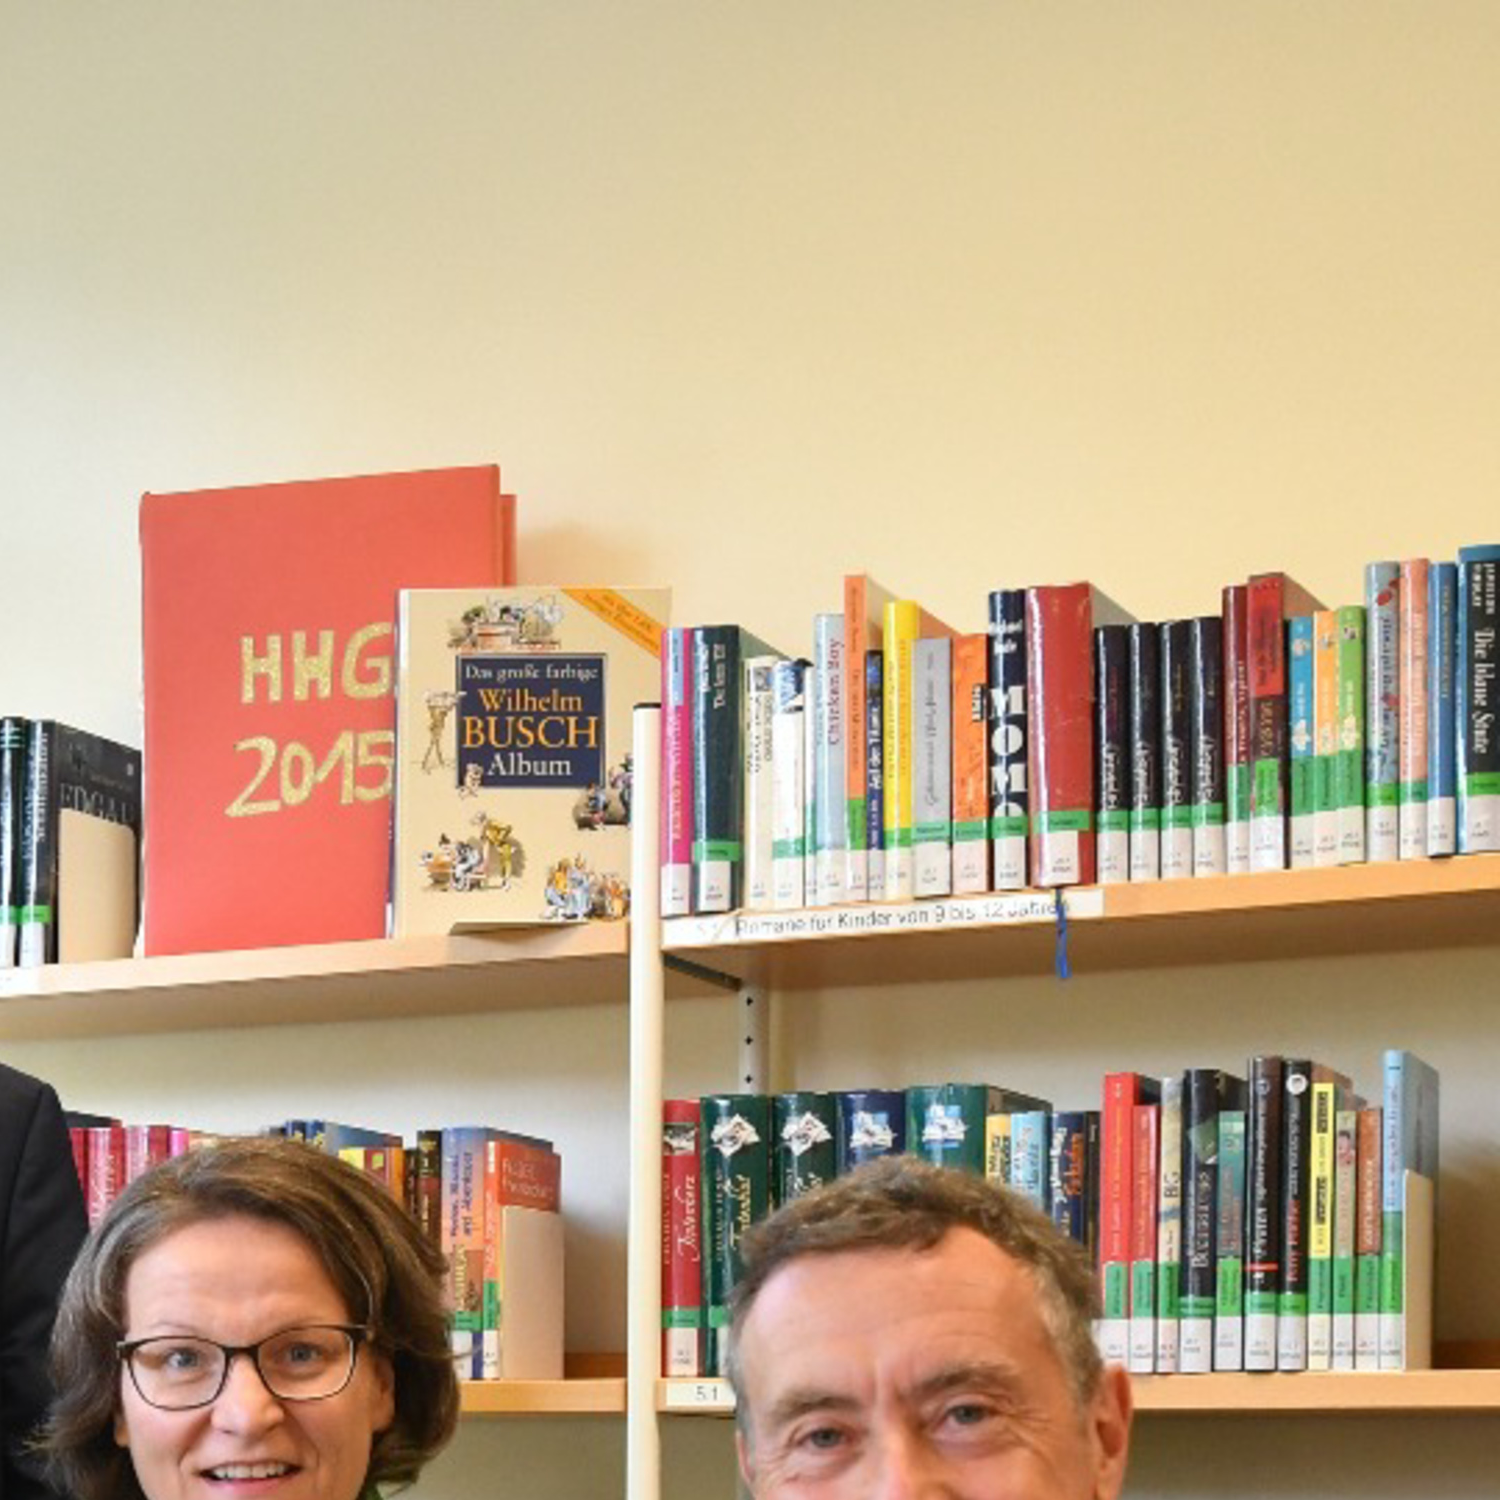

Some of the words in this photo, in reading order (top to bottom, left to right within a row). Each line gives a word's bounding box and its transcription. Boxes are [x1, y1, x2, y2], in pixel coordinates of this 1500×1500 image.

[1473, 626, 1496, 658] Die
[240, 621, 393, 704] HHG
[465, 664, 494, 679] Das
[496, 664, 541, 683] große
[545, 663, 599, 683] farbige
[477, 687, 584, 712] Wilhelm
[1473, 662, 1496, 706] blaue
[462, 715, 599, 749] BUSCH
[1471, 710, 1496, 754] Stute
[224, 729, 396, 818] 2015
[486, 752, 573, 776] Album
[837, 907, 893, 928] Kinder
[898, 911, 929, 924] von
[935, 904, 946, 922] 9
[949, 903, 976, 921] bis
[983, 901, 1004, 918] 12
